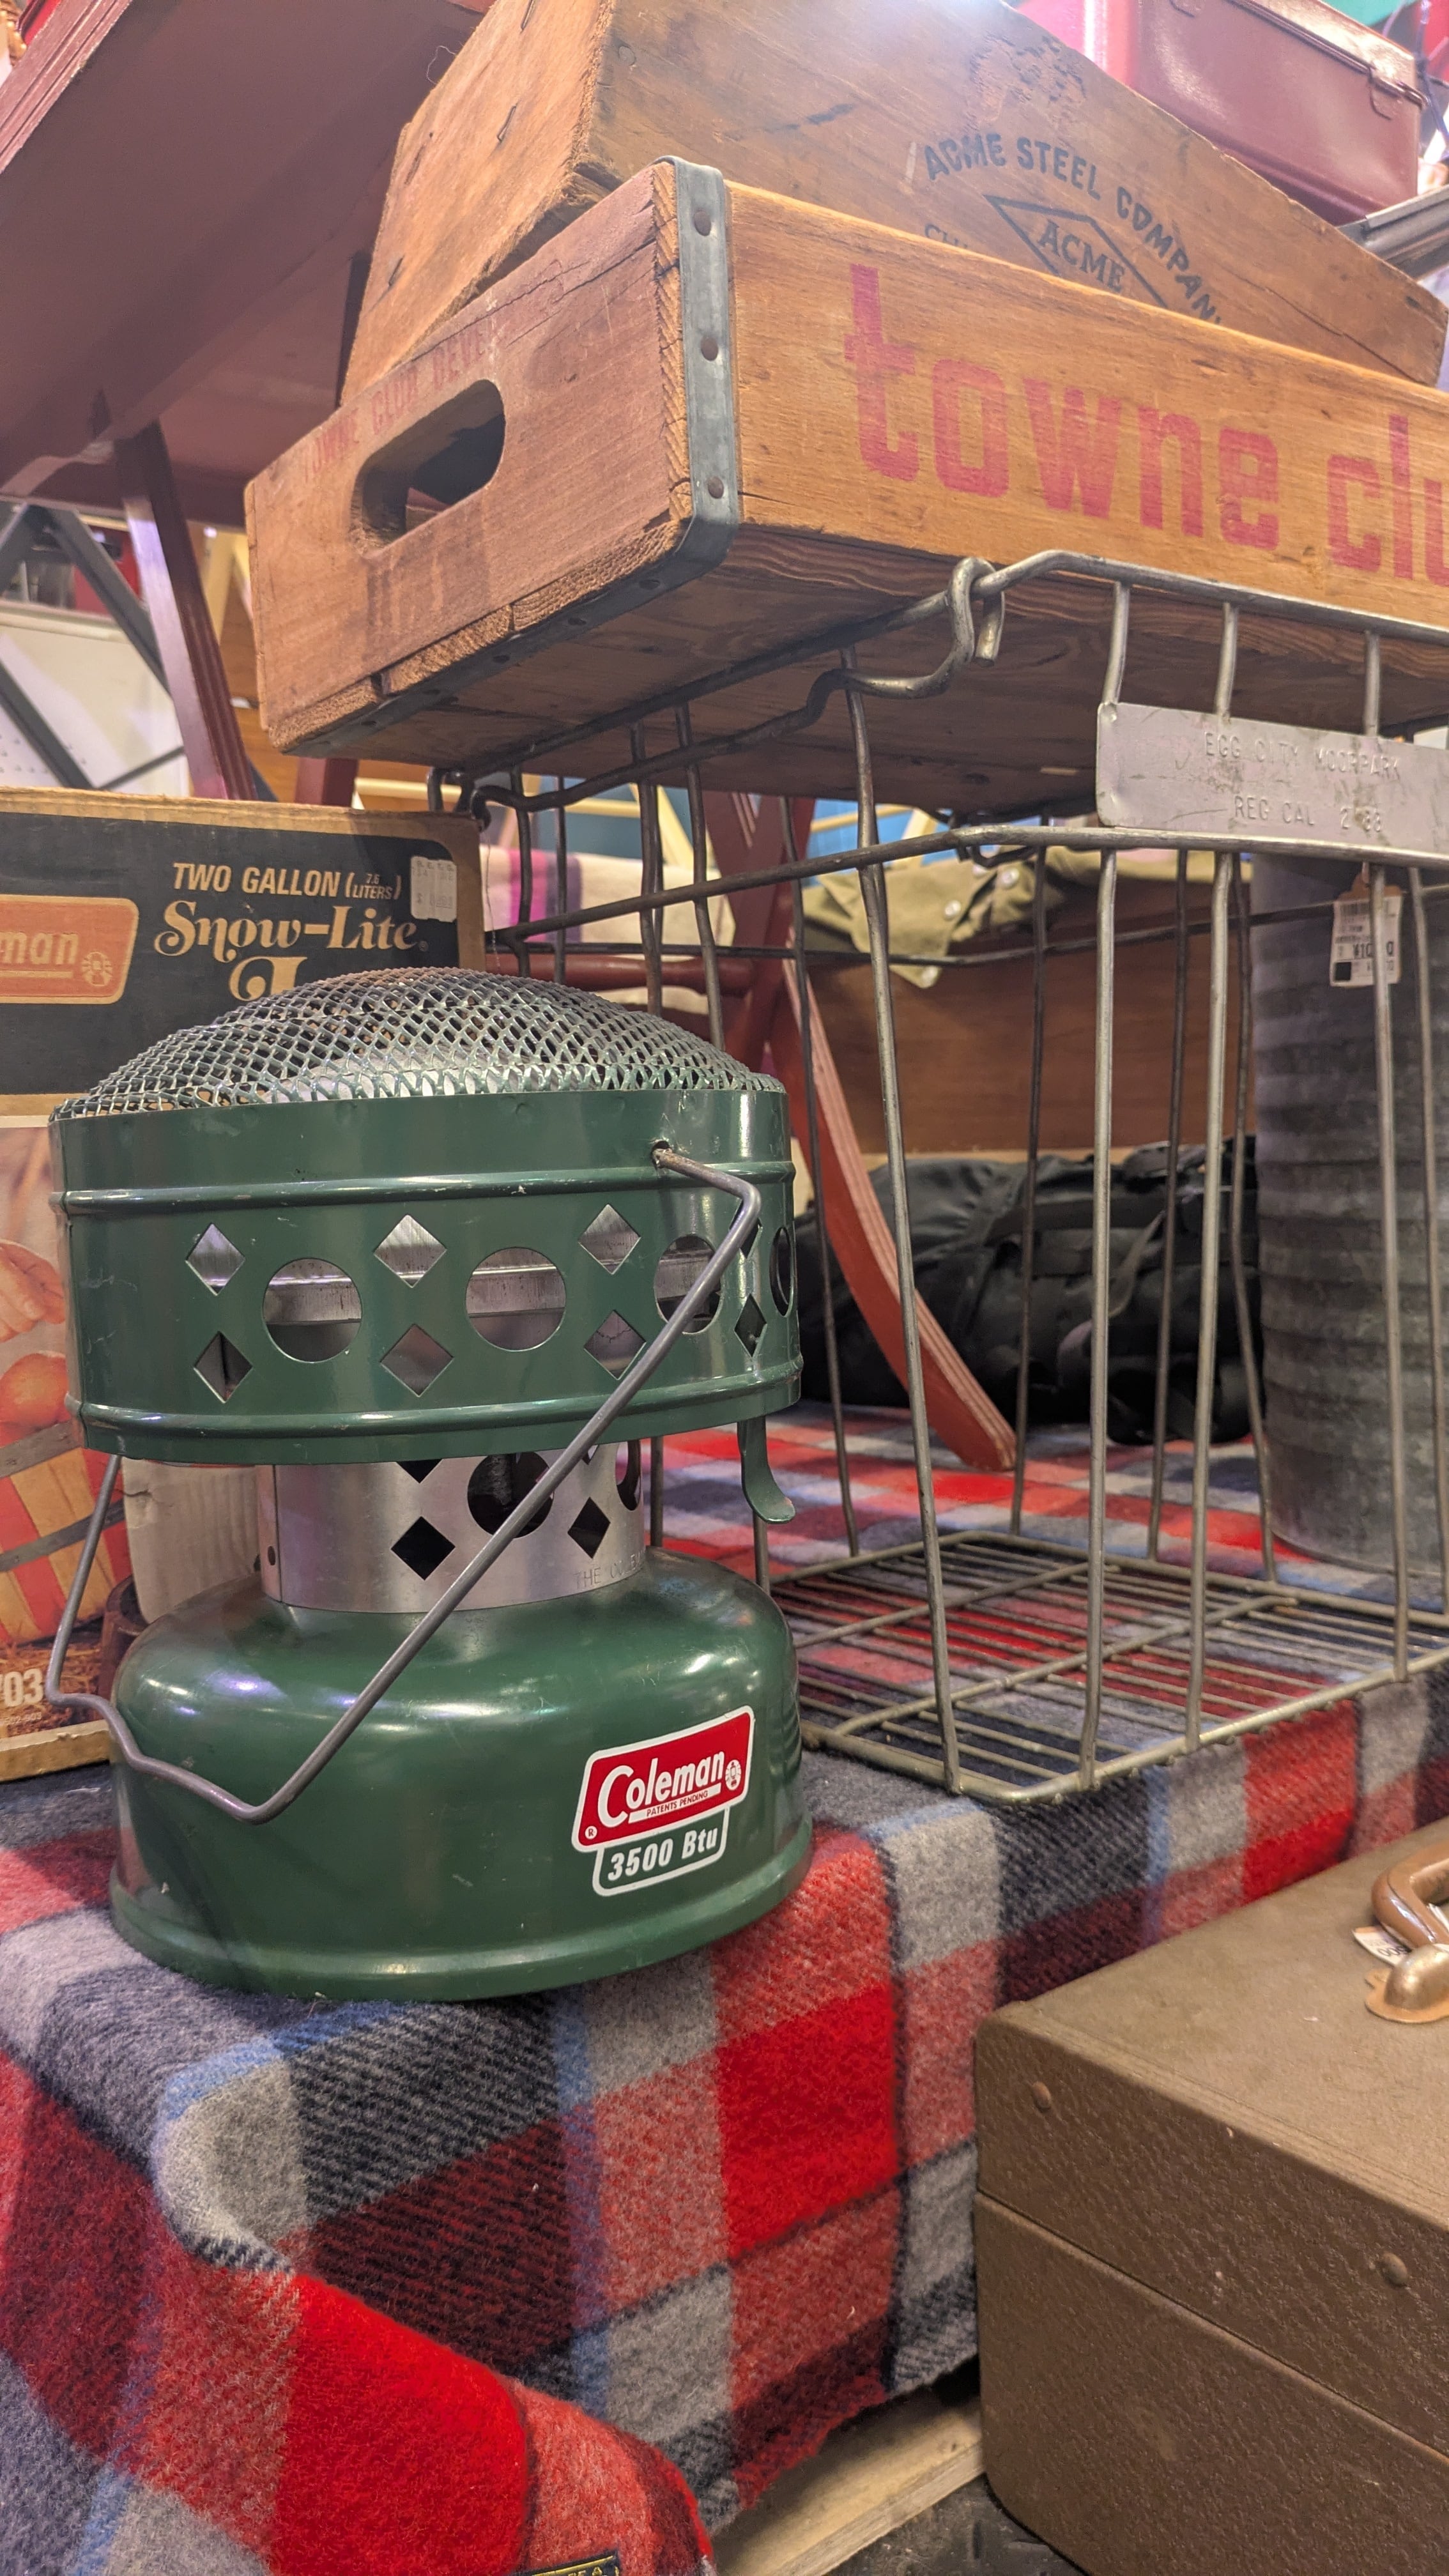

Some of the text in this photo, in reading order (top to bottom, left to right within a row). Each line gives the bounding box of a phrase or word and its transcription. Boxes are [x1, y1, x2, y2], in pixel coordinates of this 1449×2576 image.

[924, 133, 1222, 325] ACME STEEL COMPAN
[1038, 219, 1125, 293] ACME
[843, 263, 1280, 551] towne
[1204, 731, 1241, 759] EGG
[1234, 795, 1269, 821] REG
[1282, 802, 1315, 826] CAL
[173, 862, 341, 897] TWO GALLON
[0, 1668, 43, 1707] 03
[597, 1751, 724, 1828] Coleman
[646, 1790, 709, 1818] PATENTS PENDING
[608, 1828, 718, 1881] 3500 Btu
